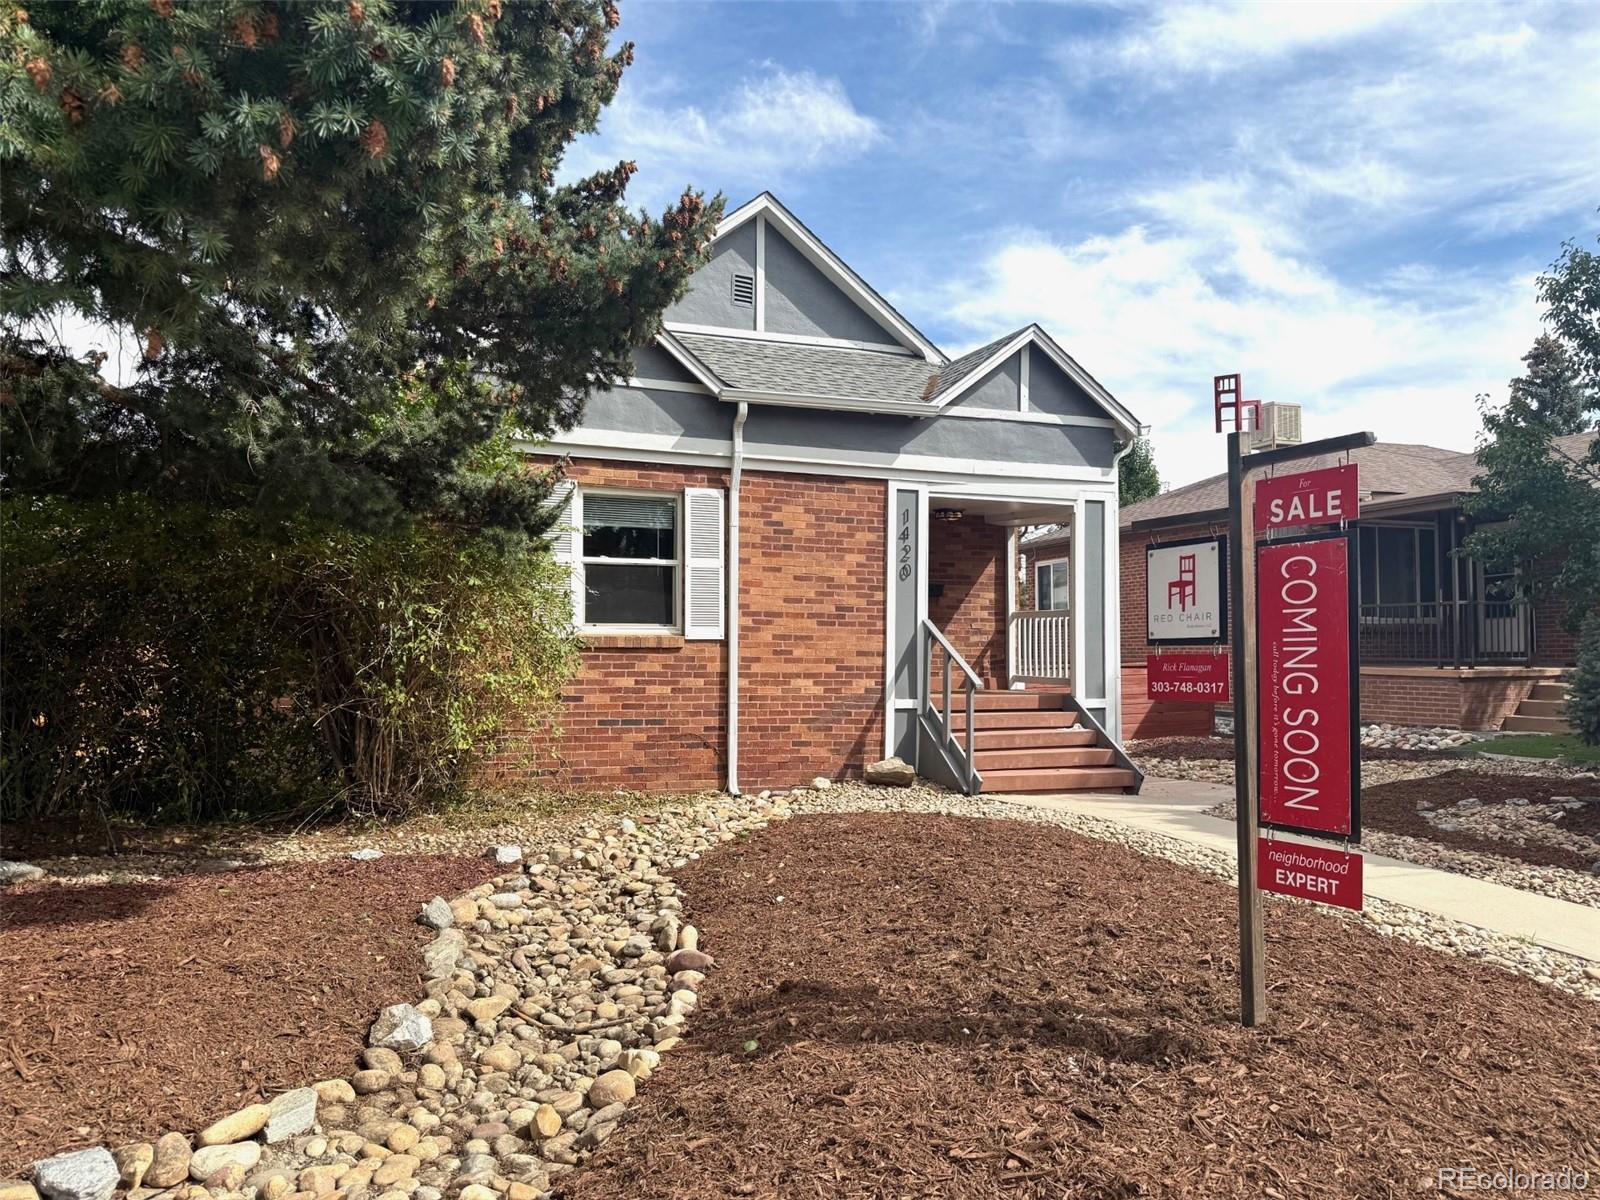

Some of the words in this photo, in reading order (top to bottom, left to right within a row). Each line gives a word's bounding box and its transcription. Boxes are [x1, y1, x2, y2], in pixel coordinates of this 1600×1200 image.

[1299, 479, 1312, 489] For
[1270, 489, 1342, 523] SALE
[898, 508, 911, 582] 1420
[1153, 614, 1174, 624] RED
[1178, 611, 1213, 623] CHAIR
[1281, 555, 1319, 695] COMING
[1162, 663, 1177, 672] Rick
[1178, 662, 1212, 674] Flanagan
[1271, 659, 1279, 684] today
[1151, 682, 1224, 695] 303-748-0317
[1272, 685, 1280, 712] before
[1283, 707, 1320, 811] SOON
[1268, 850, 1350, 875] neighborhood
[1275, 868, 1340, 896] EXPERT
